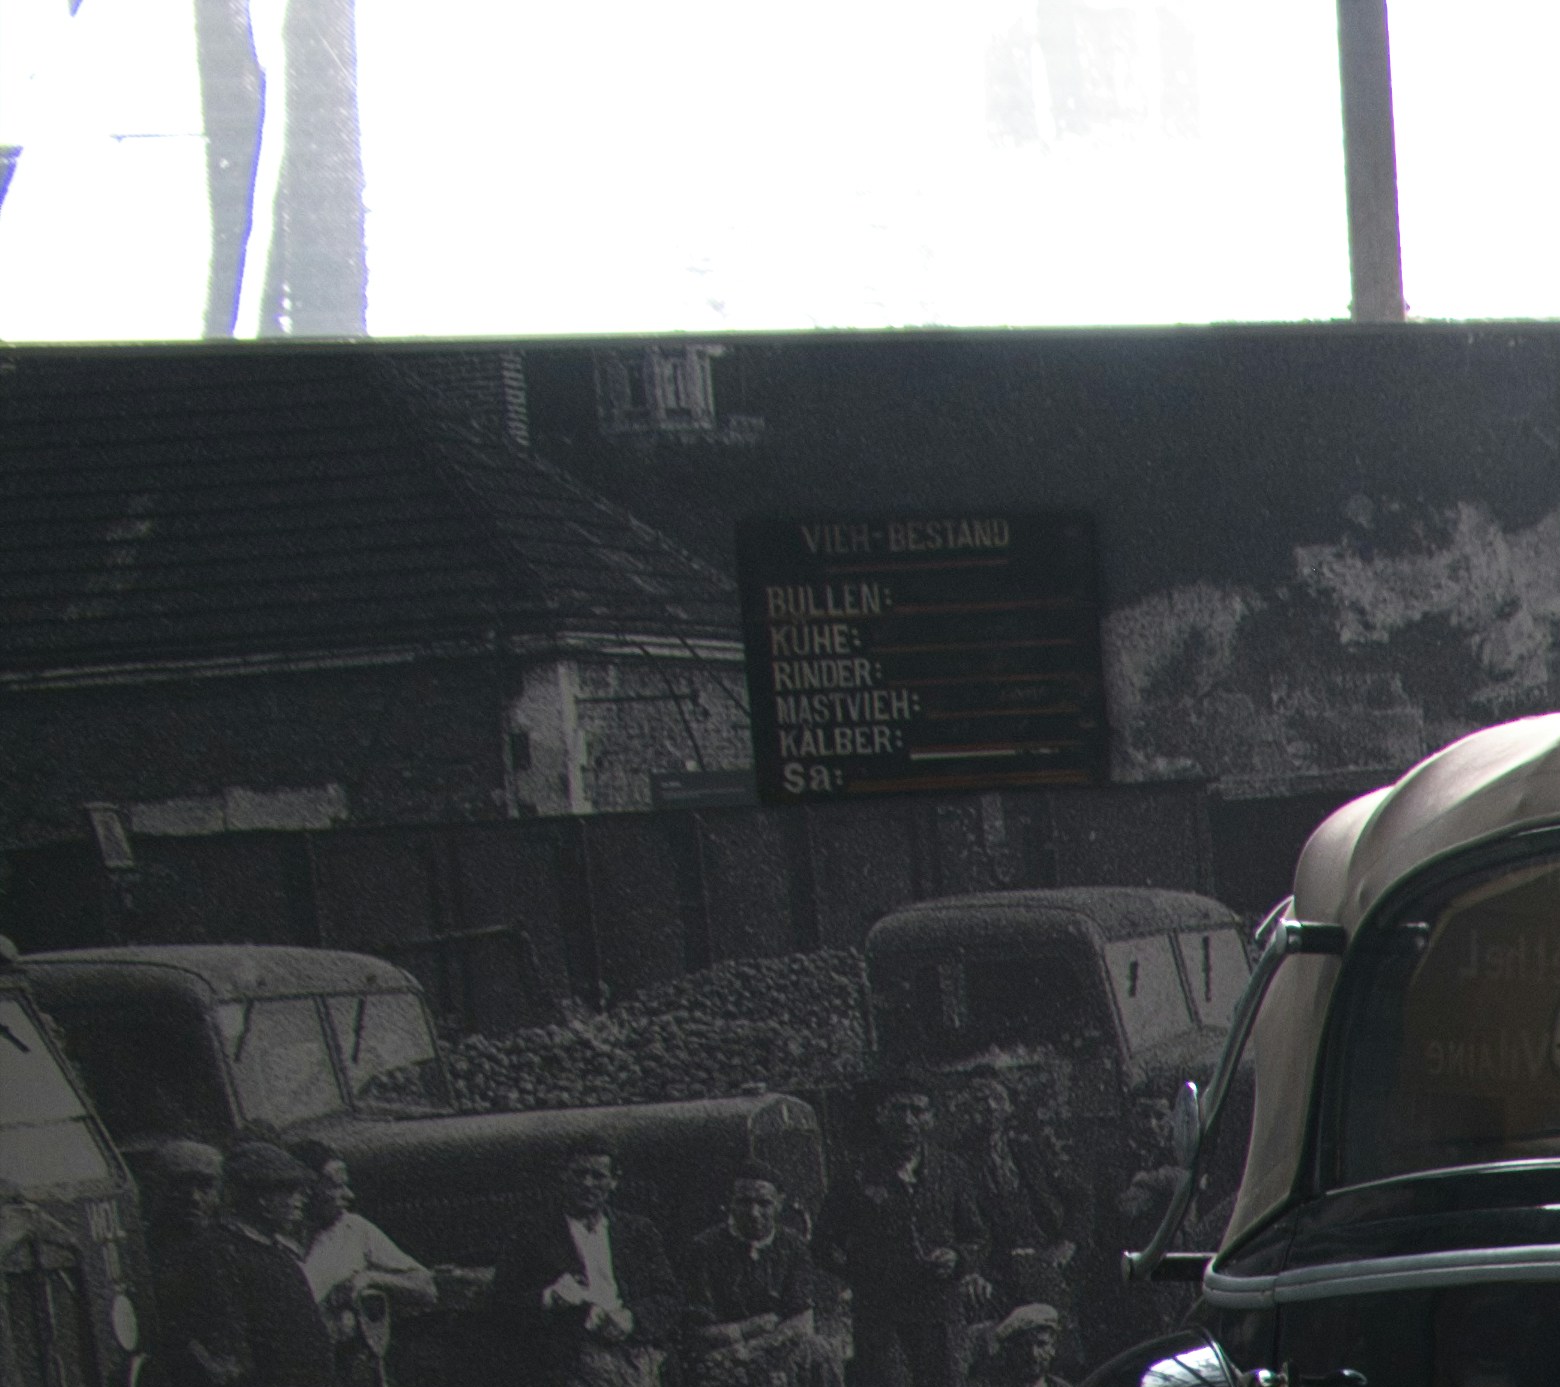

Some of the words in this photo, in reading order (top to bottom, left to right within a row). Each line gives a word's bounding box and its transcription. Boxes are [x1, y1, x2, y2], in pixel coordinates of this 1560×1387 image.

[765, 581, 894, 619] BULLEN:
[771, 656, 883, 692] RINDER:
[774, 688, 923, 725] MASTVIEH:
